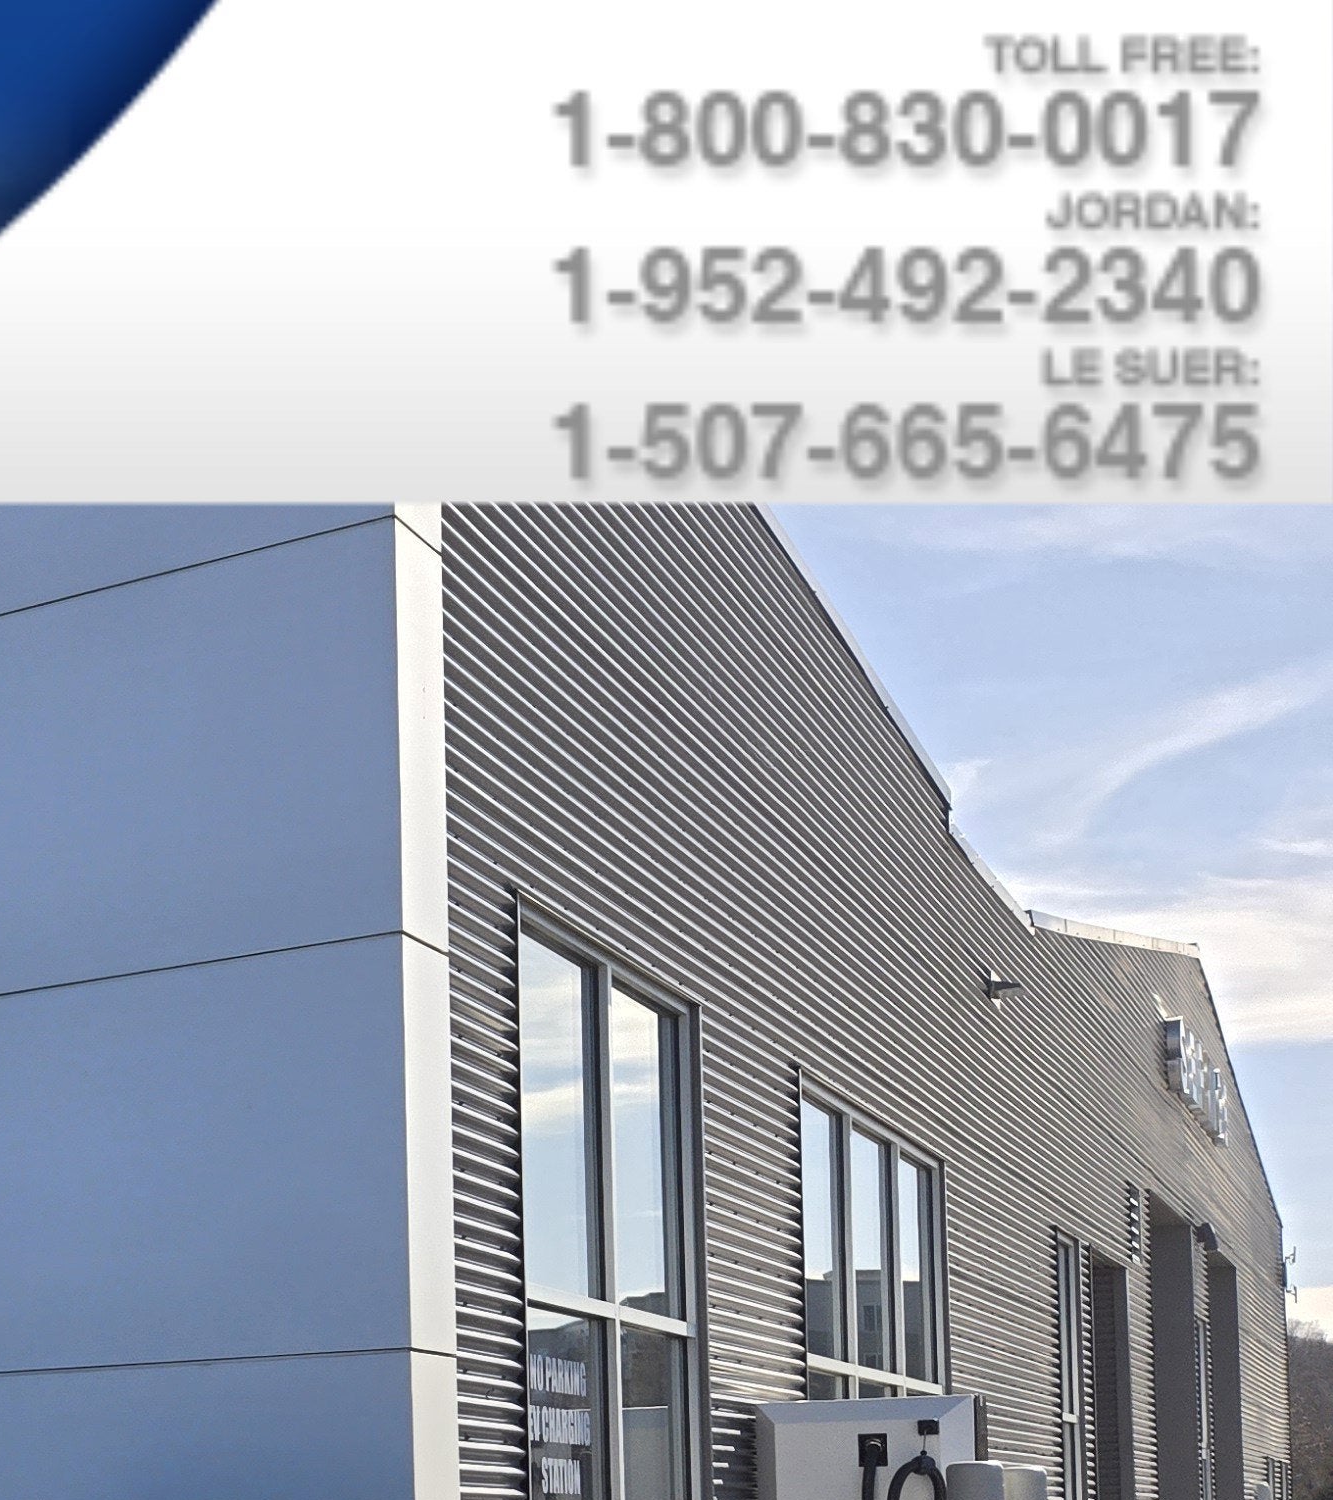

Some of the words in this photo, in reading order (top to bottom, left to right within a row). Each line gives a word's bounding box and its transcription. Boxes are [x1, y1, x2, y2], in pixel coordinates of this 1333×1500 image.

[530, 1353, 544, 1391] NO
[545, 1356, 587, 1397] PARKING
[541, 1405, 591, 1446] CHARGING
[541, 1456, 581, 1495] STATION
